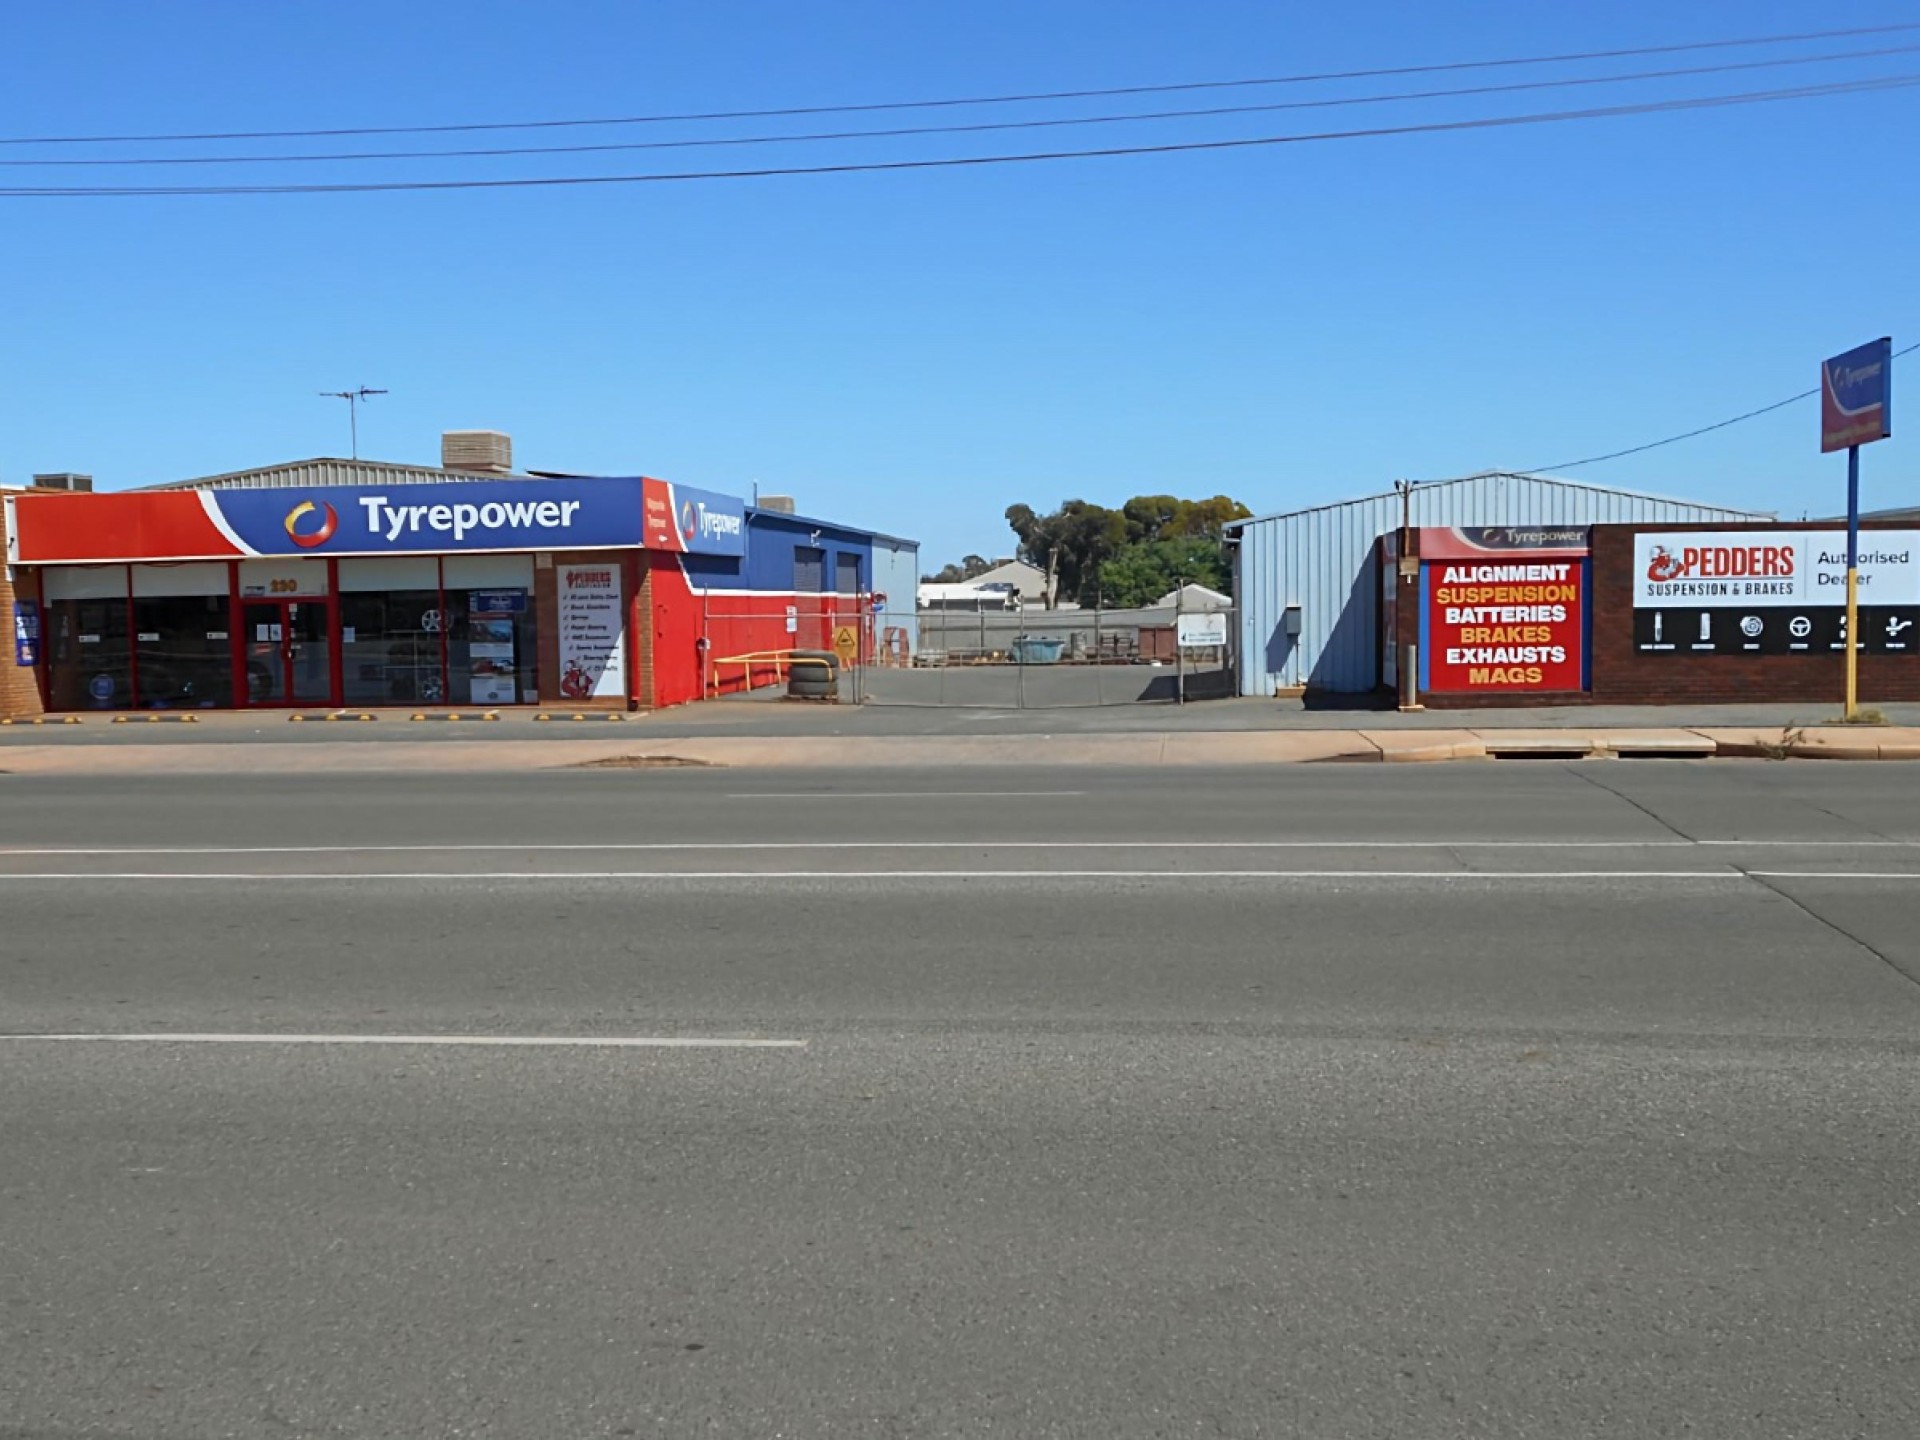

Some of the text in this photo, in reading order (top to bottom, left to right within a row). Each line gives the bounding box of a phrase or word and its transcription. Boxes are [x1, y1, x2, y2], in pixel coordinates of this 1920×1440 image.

[359, 496, 580, 541] Tyrepower
[697, 503, 741, 541] Tyrepower
[1505, 528, 1584, 545] Tyrepower
[1683, 546, 1794, 577] PEDDERS
[1818, 550, 1909, 564] Autorised
[1442, 564, 1571, 583] ALIGNMENT
[1818, 573, 1872, 585] Deaer
[1436, 585, 1576, 604] SUSPENSION
[1647, 583, 1794, 596] SUSPENSION & BRAKES
[1445, 605, 1567, 624] BATTERIES
[1460, 626, 1551, 644] BRAKES
[1446, 646, 1566, 664] EXHAUSTS
[1469, 667, 1543, 684] MAGS
